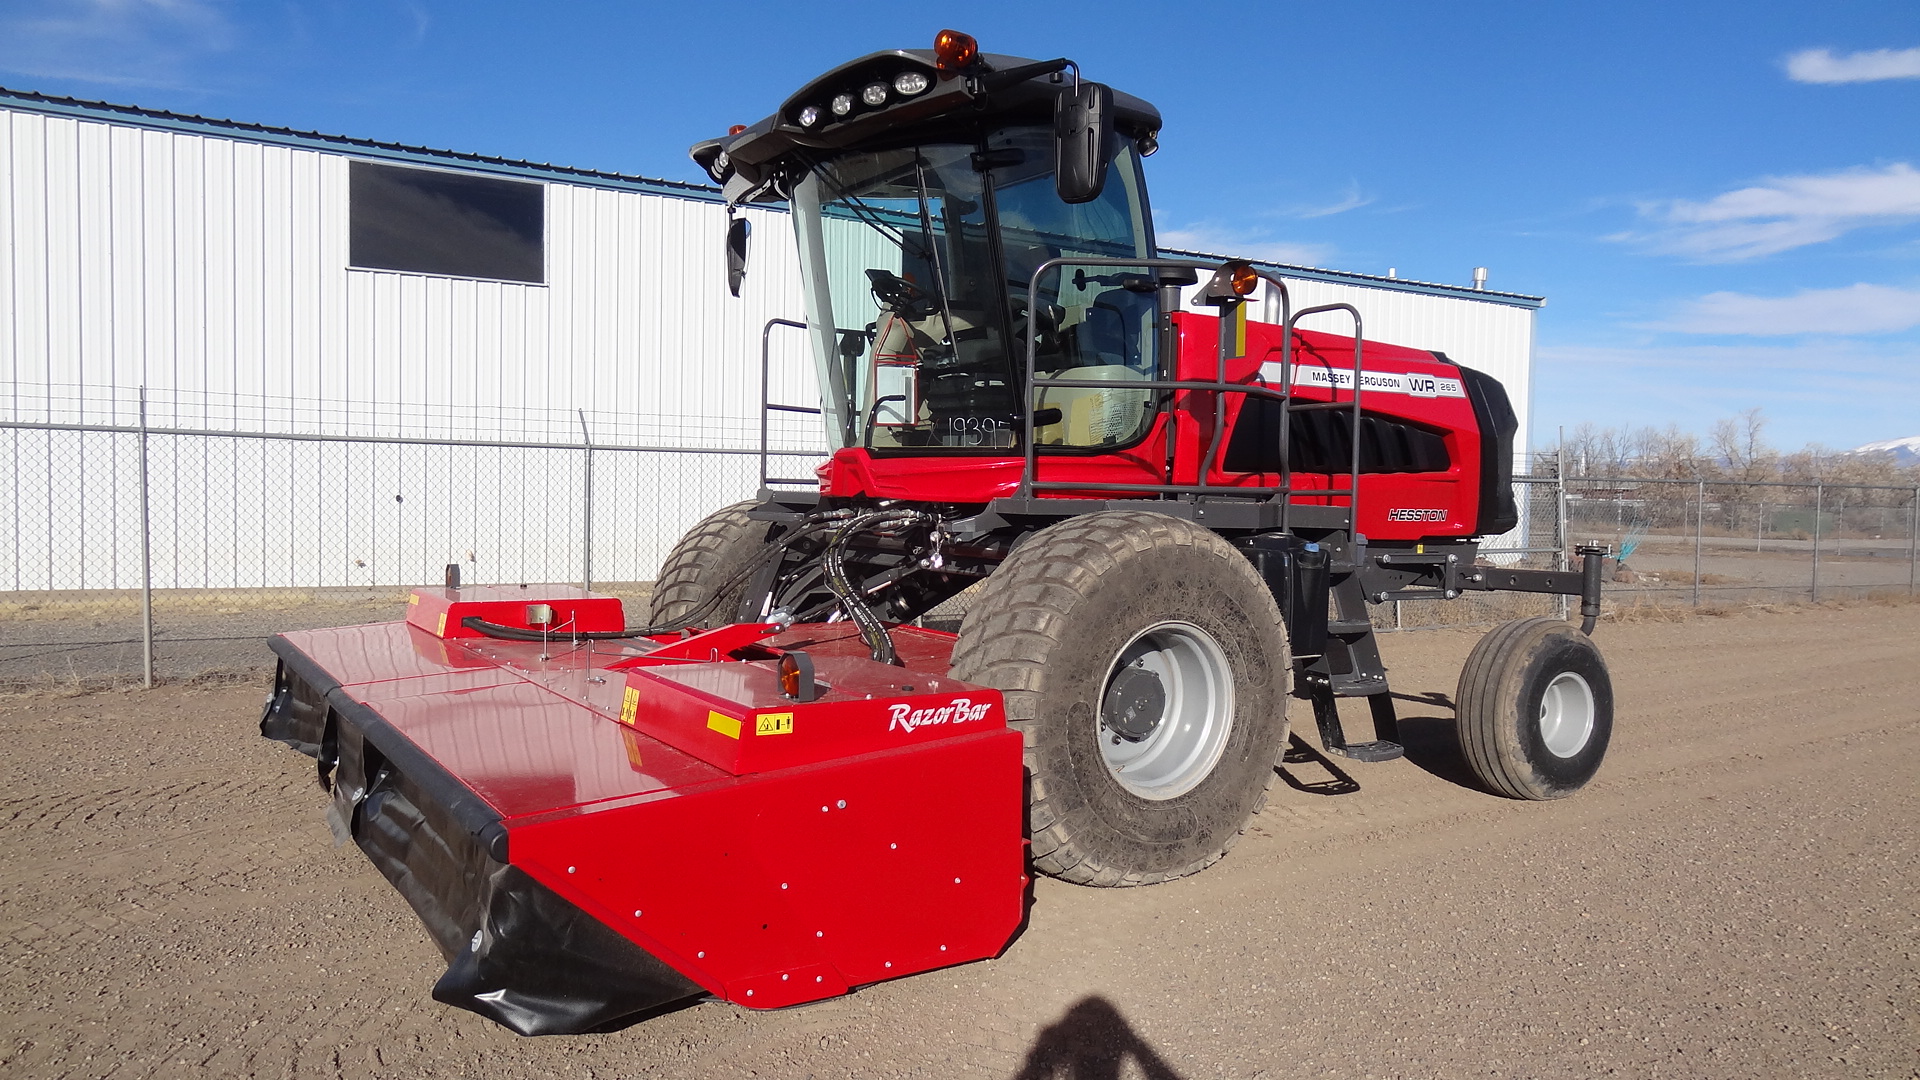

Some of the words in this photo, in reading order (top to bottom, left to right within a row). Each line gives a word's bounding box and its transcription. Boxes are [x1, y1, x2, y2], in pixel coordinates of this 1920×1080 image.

[1312, 371, 1351, 384] MASSEY
[1358, 375, 1400, 388] ERGUSON
[1408, 377, 1436, 393] WR
[1440, 383, 1457, 392] 265
[1388, 508, 1448, 522] HESSTON
[888, 698, 992, 733] RazorBar
